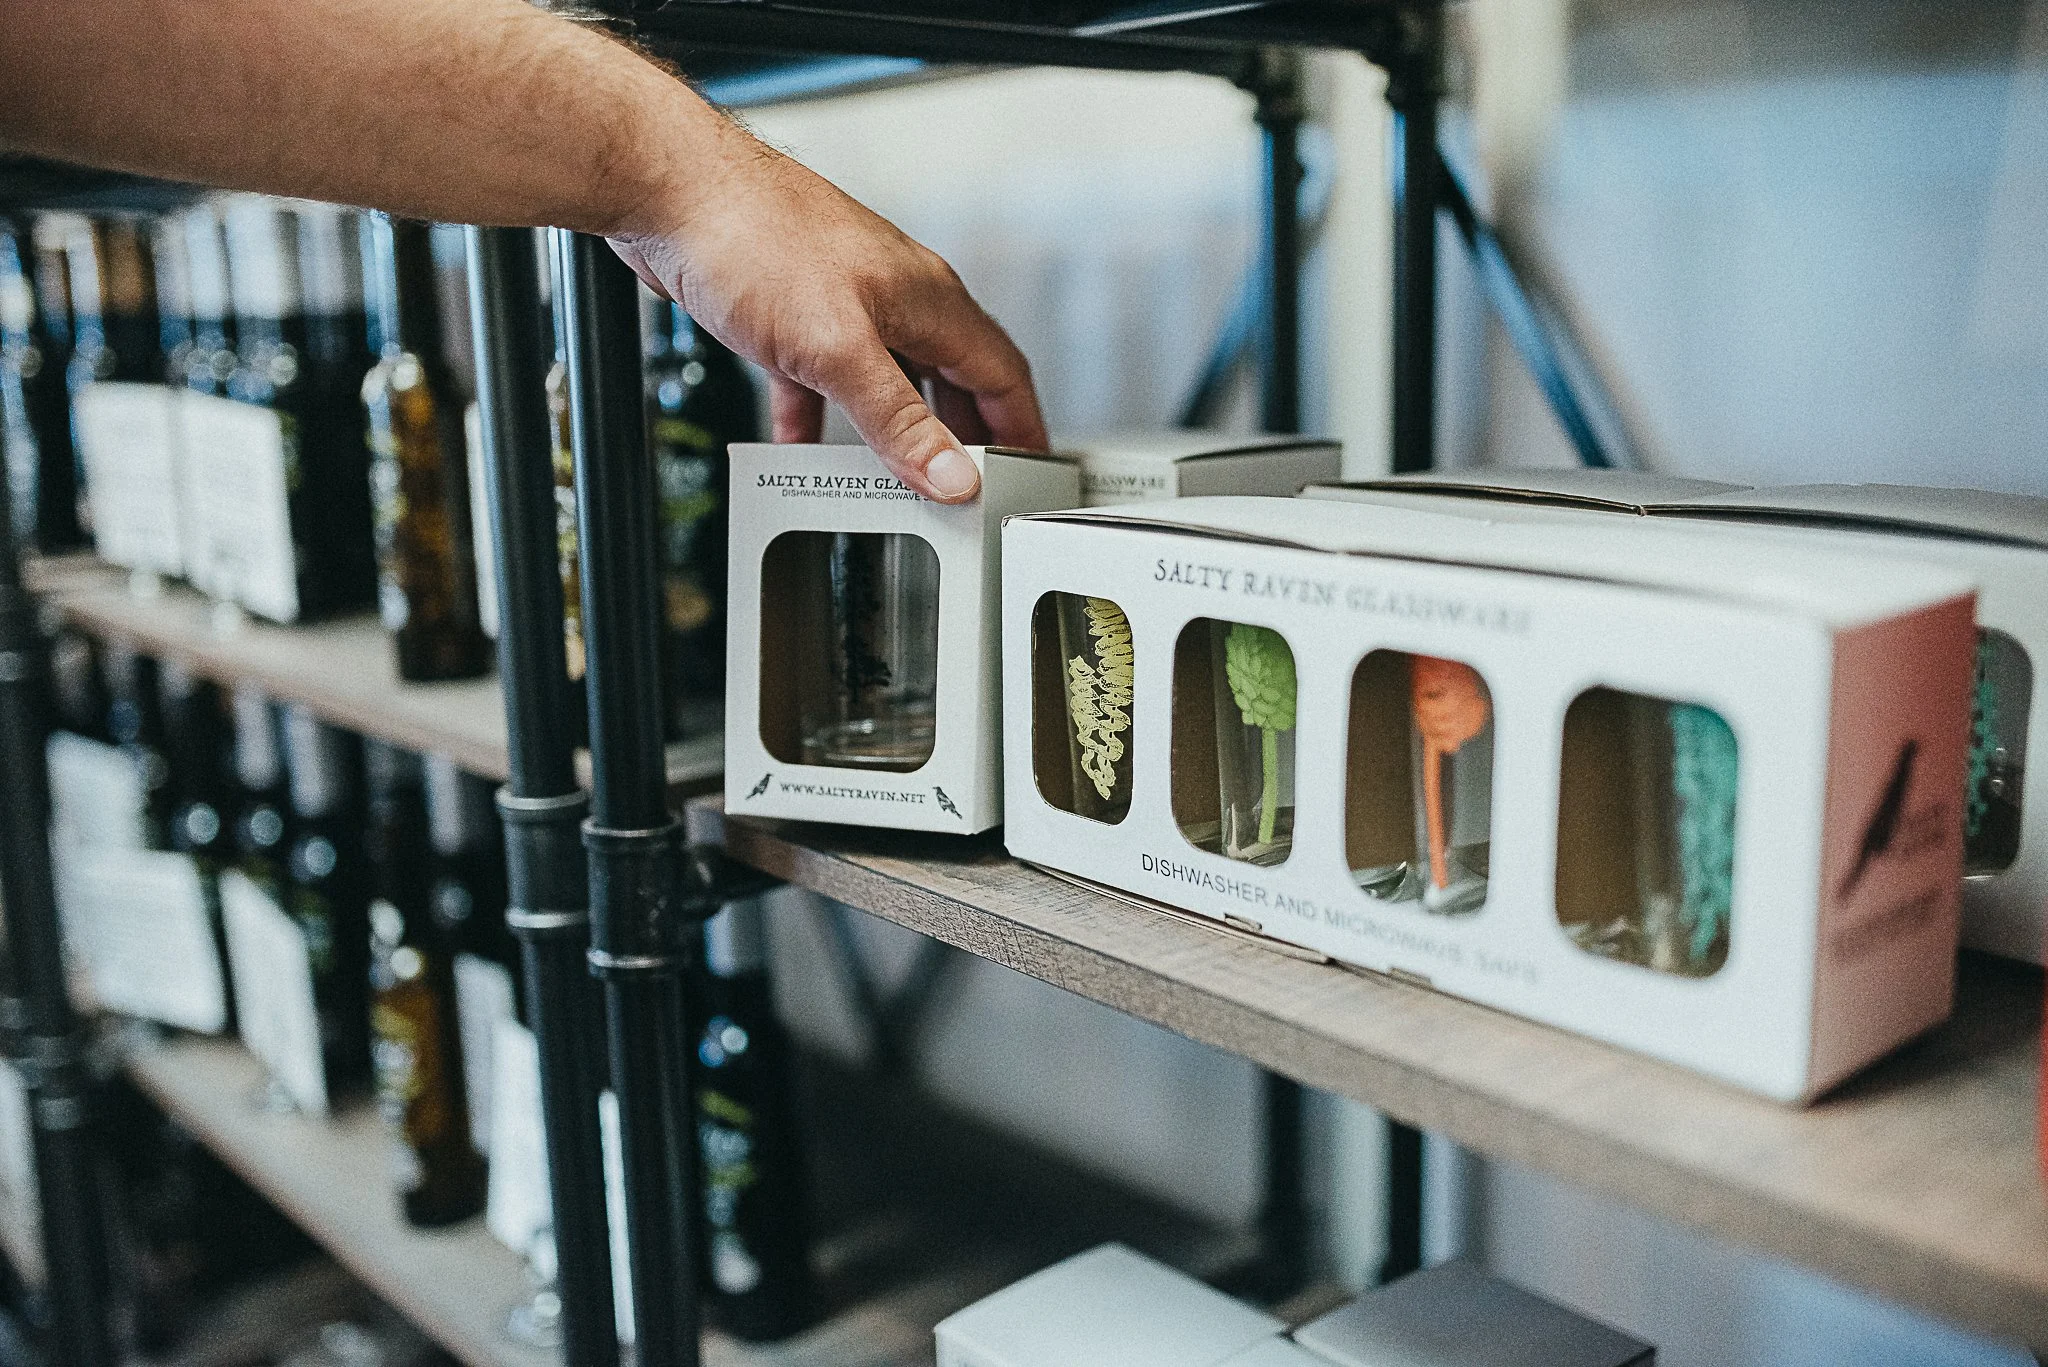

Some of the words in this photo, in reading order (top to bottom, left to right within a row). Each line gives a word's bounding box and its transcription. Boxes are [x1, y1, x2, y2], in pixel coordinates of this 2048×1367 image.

[757, 474, 806, 488] SALTY
[814, 476, 869, 490] RAVEN
[782, 488, 841, 499] DISHWASHER
[844, 490, 862, 500] AND
[864, 491, 921, 501] MICROWAVE
[1154, 558, 1232, 592] SALTY
[1242, 571, 1335, 606] RAVEN
[780, 782, 926, 804] WWW.SALTYRAVEN.NET
[1141, 853, 1269, 908] DISHWASHER
[1274, 893, 1318, 920] AND
